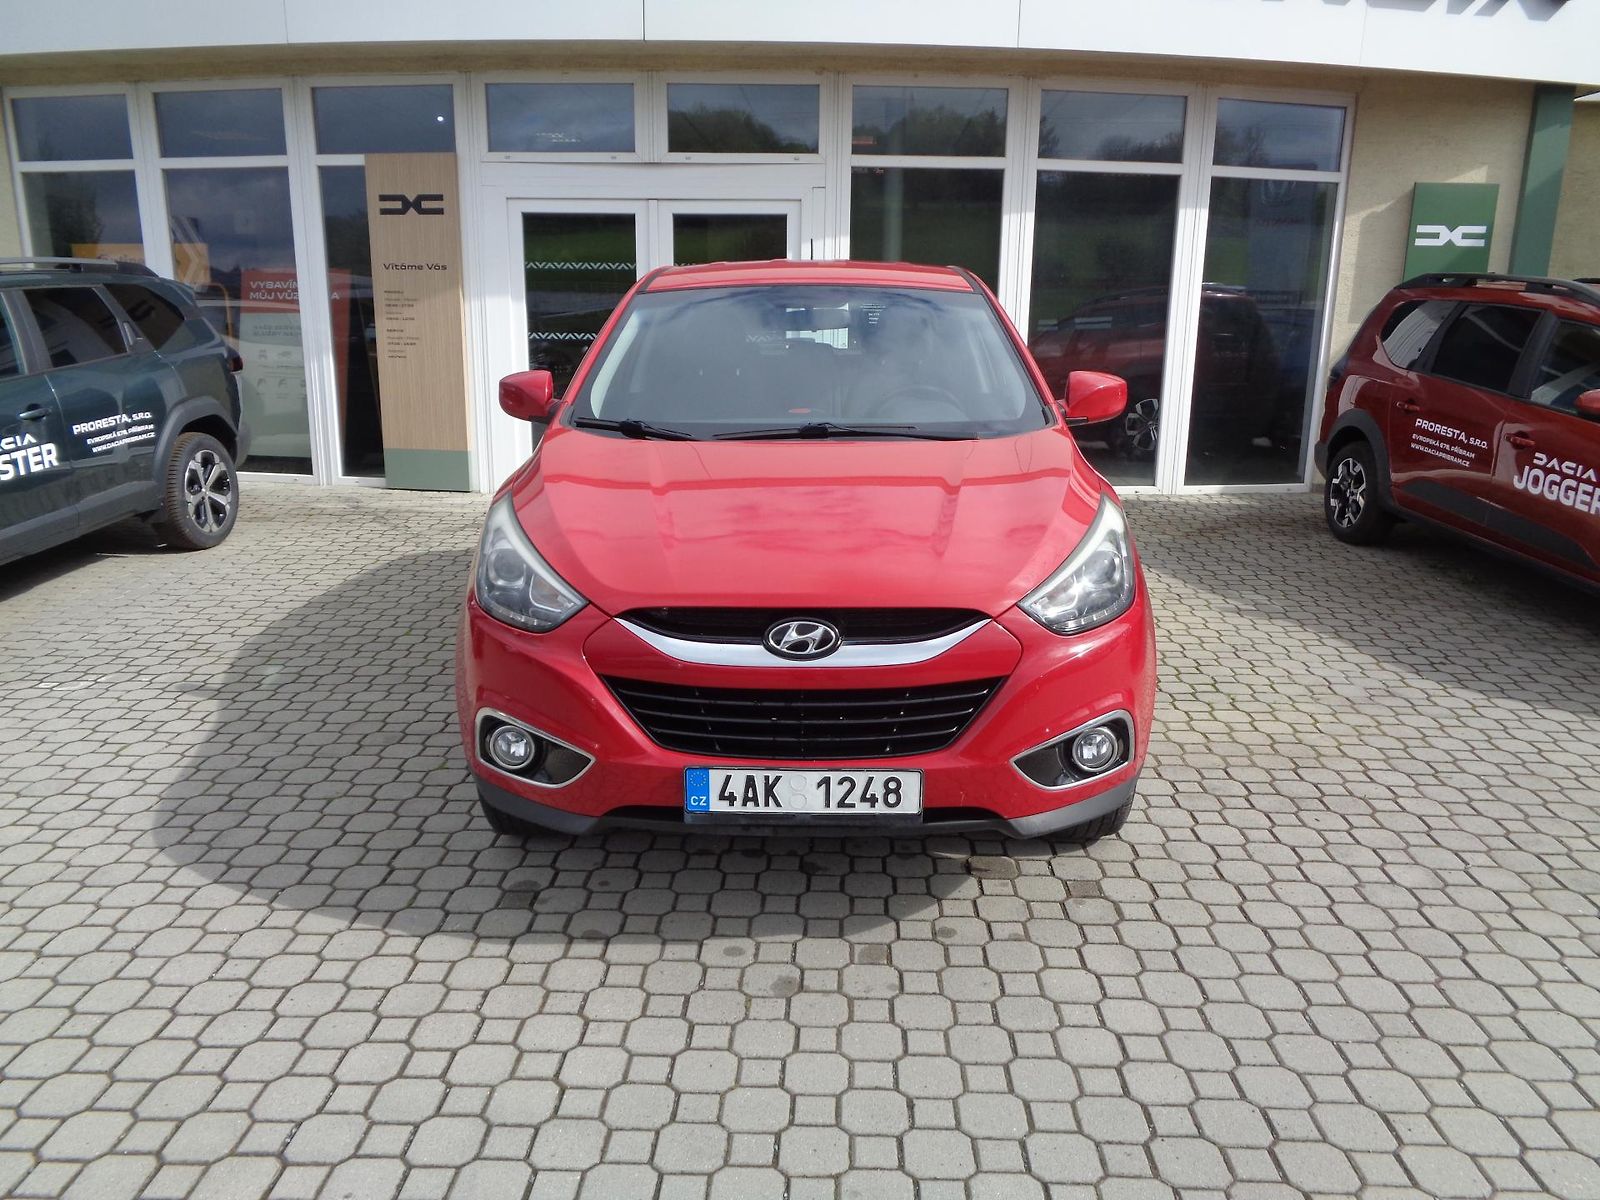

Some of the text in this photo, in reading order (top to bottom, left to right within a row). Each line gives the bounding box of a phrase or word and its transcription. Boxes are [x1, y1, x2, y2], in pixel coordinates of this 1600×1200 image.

[383, 263, 448, 271] Vitáme Vás
[249, 289, 275, 300] MŮJ
[72, 413, 132, 435] PRORESTA,
[1415, 418, 1468, 444] PRORESTA,
[0, 433, 37, 450] CIA
[0, 443, 59, 481] STER
[1533, 452, 1597, 482] DACIA
[690, 796, 707, 806] CZ
[718, 774, 902, 809] 4AK 1248
